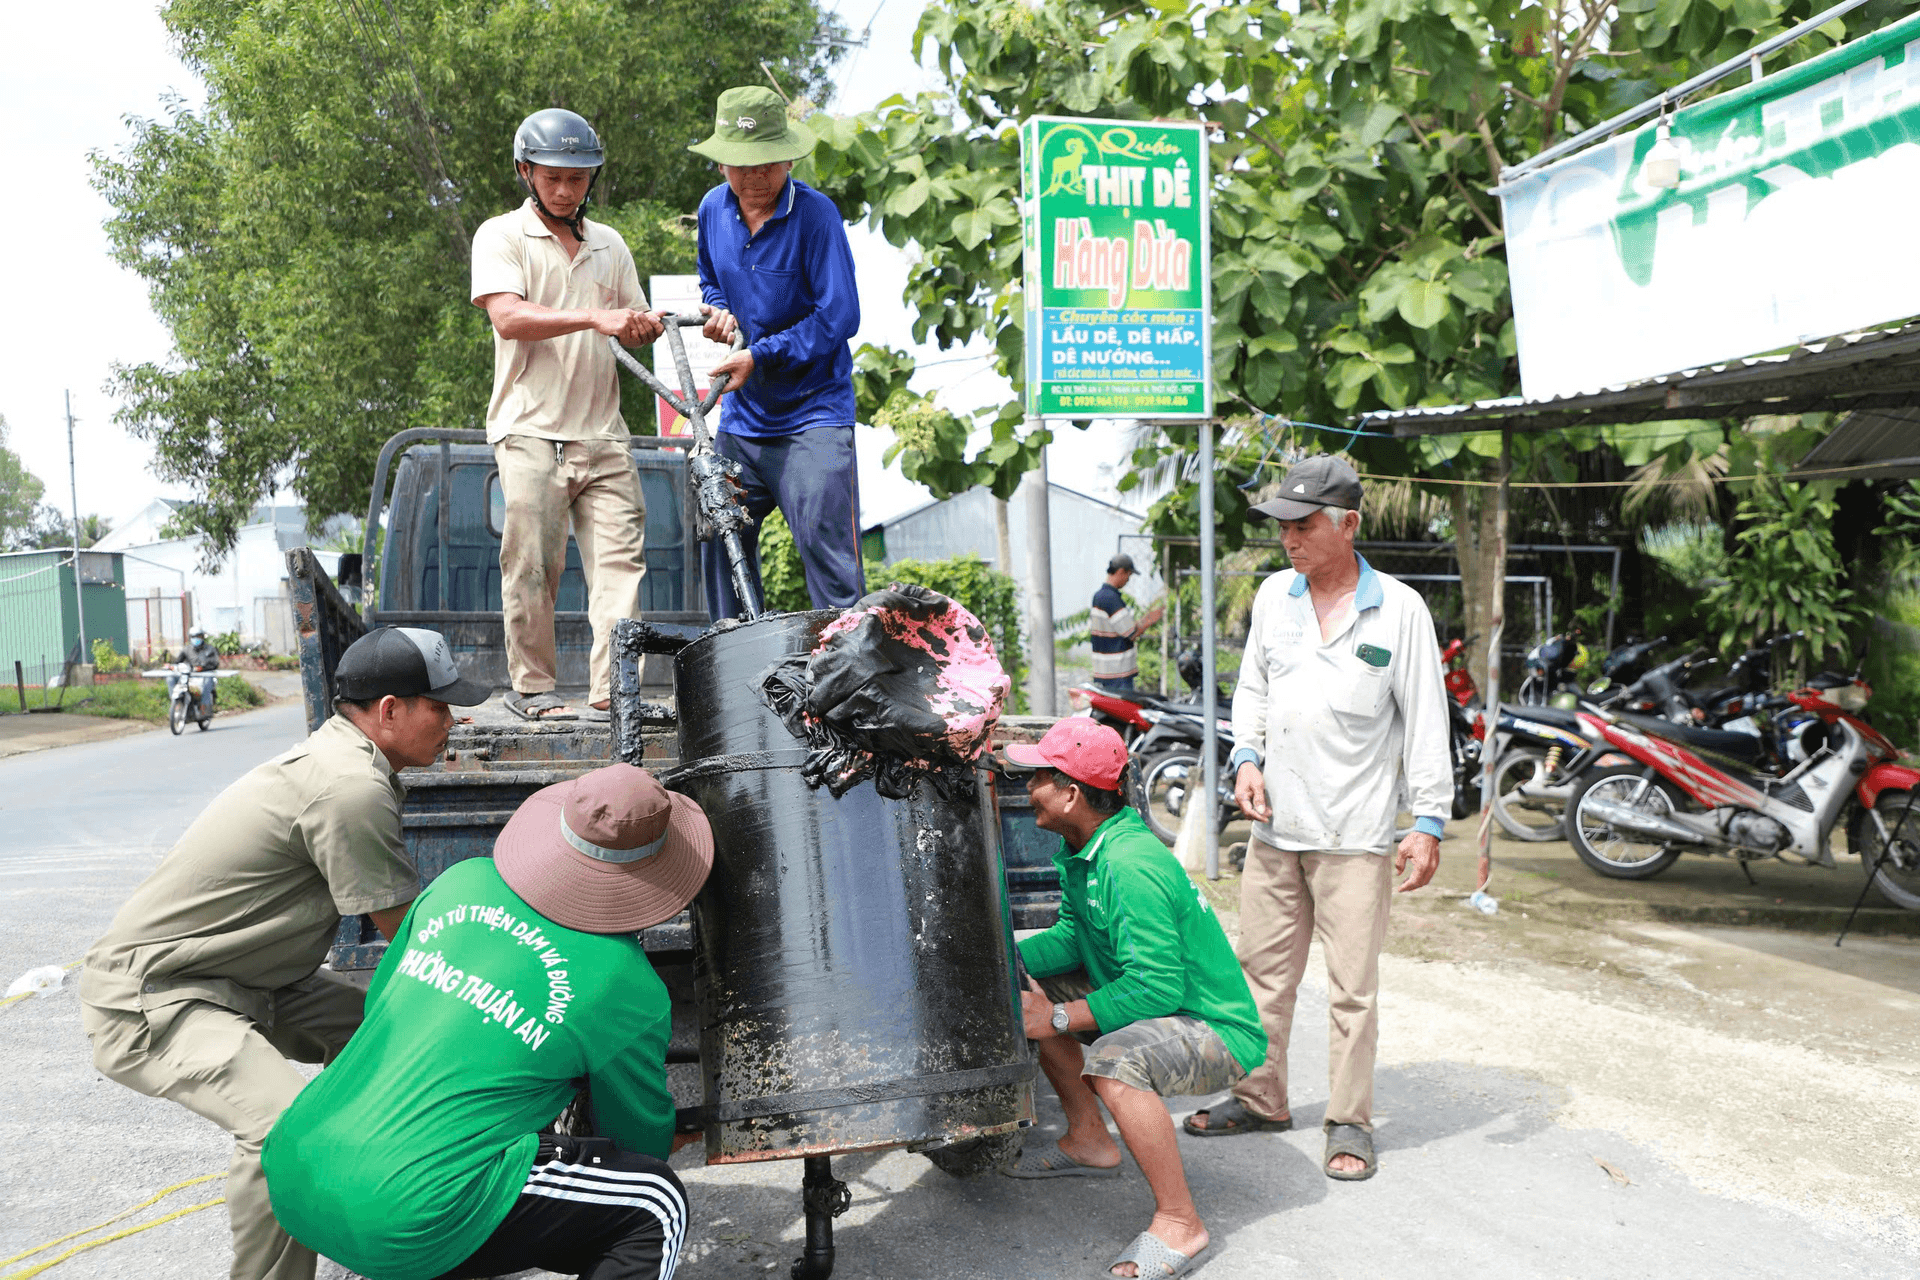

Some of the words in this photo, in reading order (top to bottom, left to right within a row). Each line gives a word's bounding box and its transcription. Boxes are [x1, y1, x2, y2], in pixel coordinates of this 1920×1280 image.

[1098, 128, 1182, 161] Quán
[1081, 165, 1147, 218] THỊT
[1152, 157, 1192, 208] DÊ
[1053, 217, 1129, 310] Hàng
[1132, 219, 1191, 291] Dừa
[1059, 311, 1118, 326] Chuyên
[1127, 326, 1152, 345] DÊ
[1052, 347, 1077, 365] DÊ
[418, 916, 444, 944] ĐỘI
[445, 904, 467, 926] TỪ
[469, 905, 516, 932] THIỆN
[544, 969, 575, 1025] ĐƯỜNG
[456, 974, 525, 1029] THUẬN
[513, 1017, 551, 1051] AN
